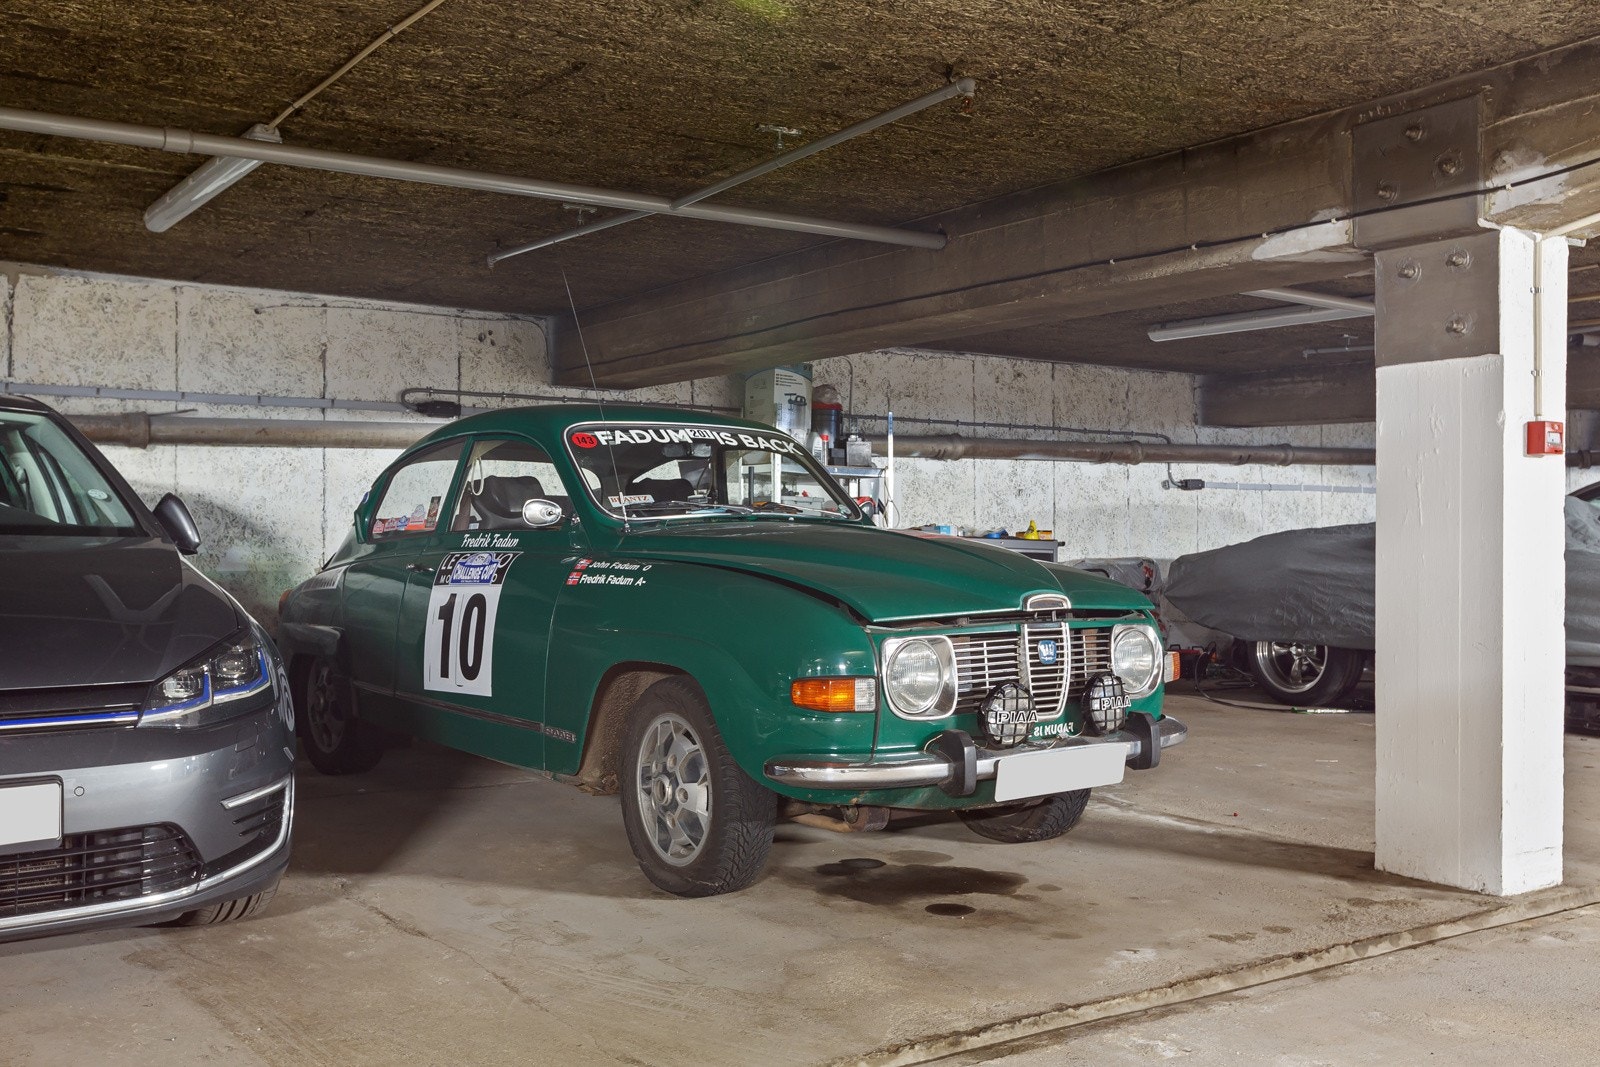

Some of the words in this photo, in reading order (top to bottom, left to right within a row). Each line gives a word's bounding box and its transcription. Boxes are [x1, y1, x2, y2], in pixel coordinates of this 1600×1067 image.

[576, 436, 594, 446] 143
[594, 429, 693, 445] FADUM
[713, 431, 738, 446] IS
[738, 434, 803, 455] BACK
[461, 533, 491, 548] Fredrik
[453, 564, 484, 580] CHALLENGE
[481, 563, 497, 580] CUP
[589, 560, 611, 569] John
[609, 561, 641, 571] Fadum
[579, 574, 607, 584] Fredrik
[606, 574, 634, 586] Fadum
[437, 593, 487, 681] 10
[1101, 696, 1131, 710] PIAA
[997, 711, 1038, 724] PIAA
